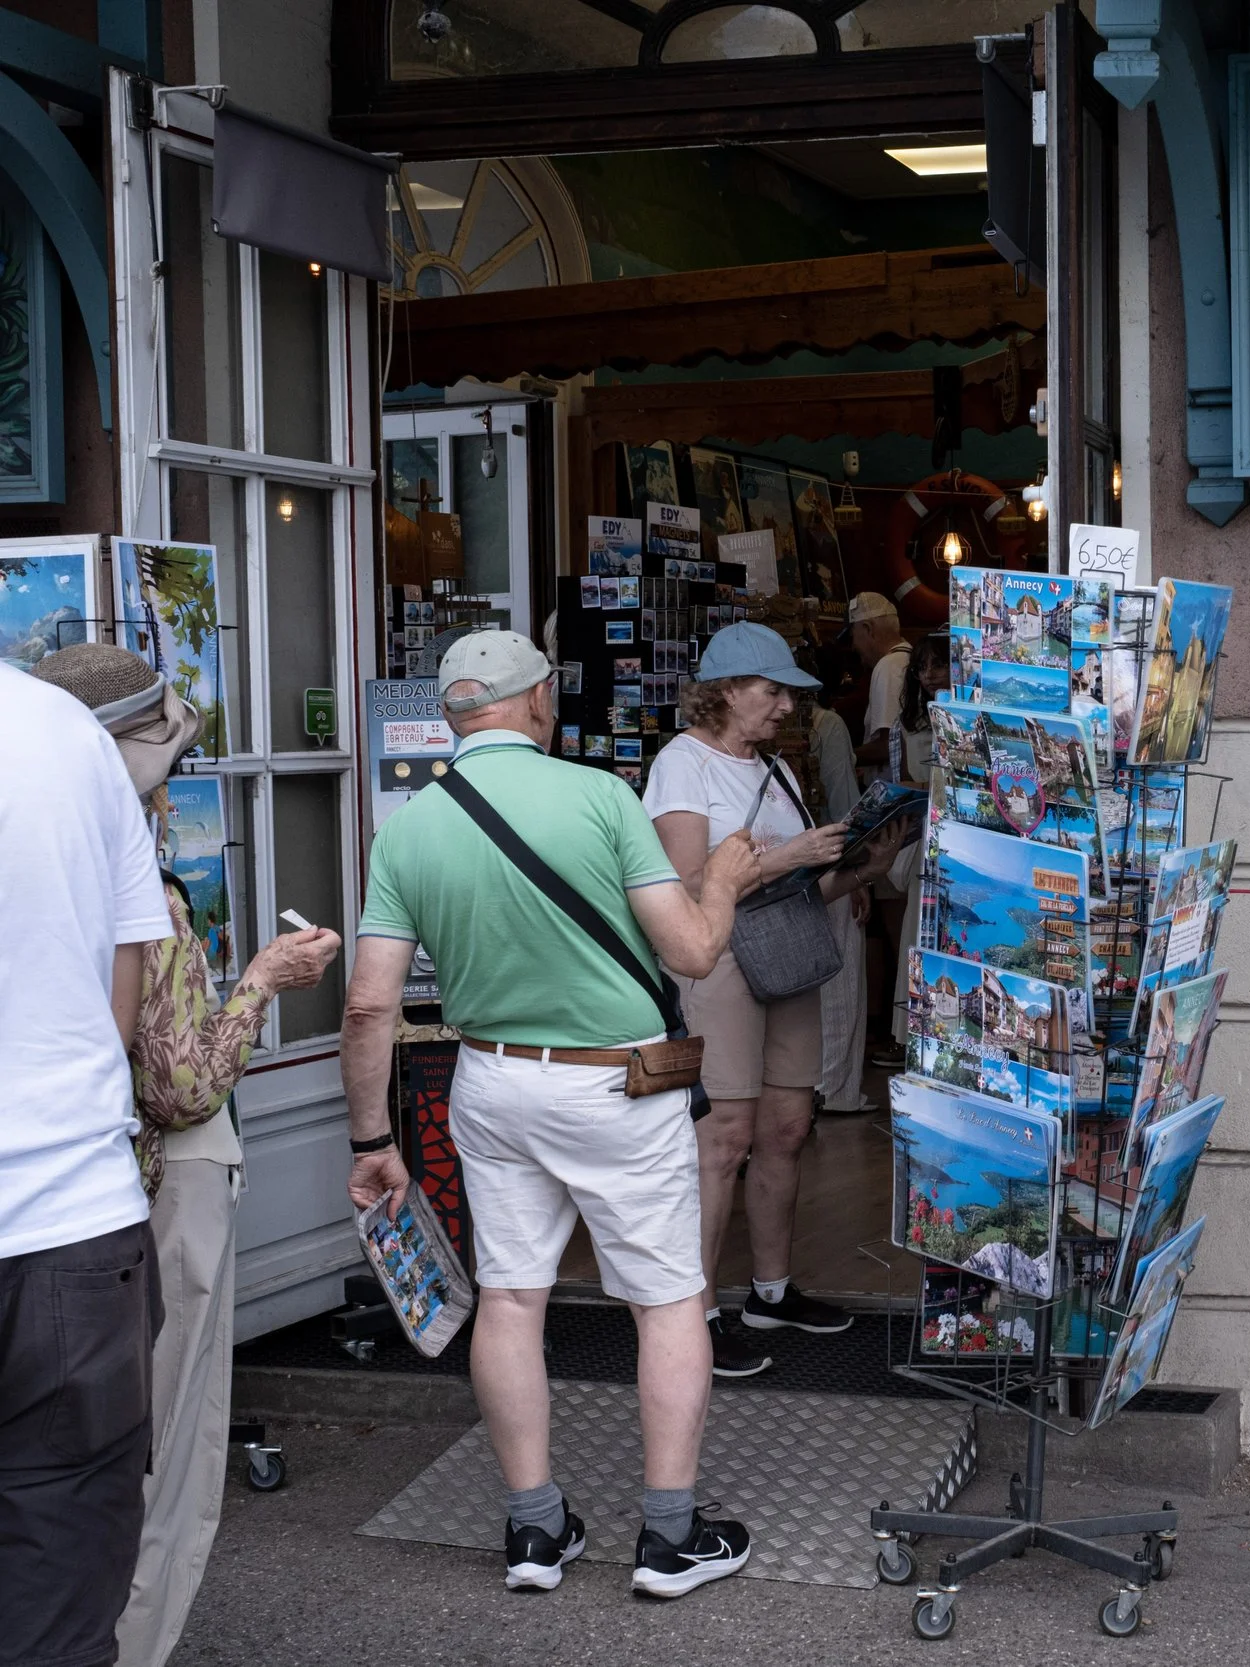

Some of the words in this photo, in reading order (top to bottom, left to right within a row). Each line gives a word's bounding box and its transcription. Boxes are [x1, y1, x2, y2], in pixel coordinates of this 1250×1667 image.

[661, 507, 680, 522] EDY
[602, 520, 621, 535] EDY
[1078, 538, 1134, 572] 6,50€
[1005, 576, 1044, 594] Annecy
[385, 724, 424, 734] COMPAGNIE
[390, 734, 424, 744] BATEAUX
[992, 757, 1040, 780] Annecy
[170, 793, 200, 804] ANNECY
[1046, 944, 1070, 954] ANNECY
